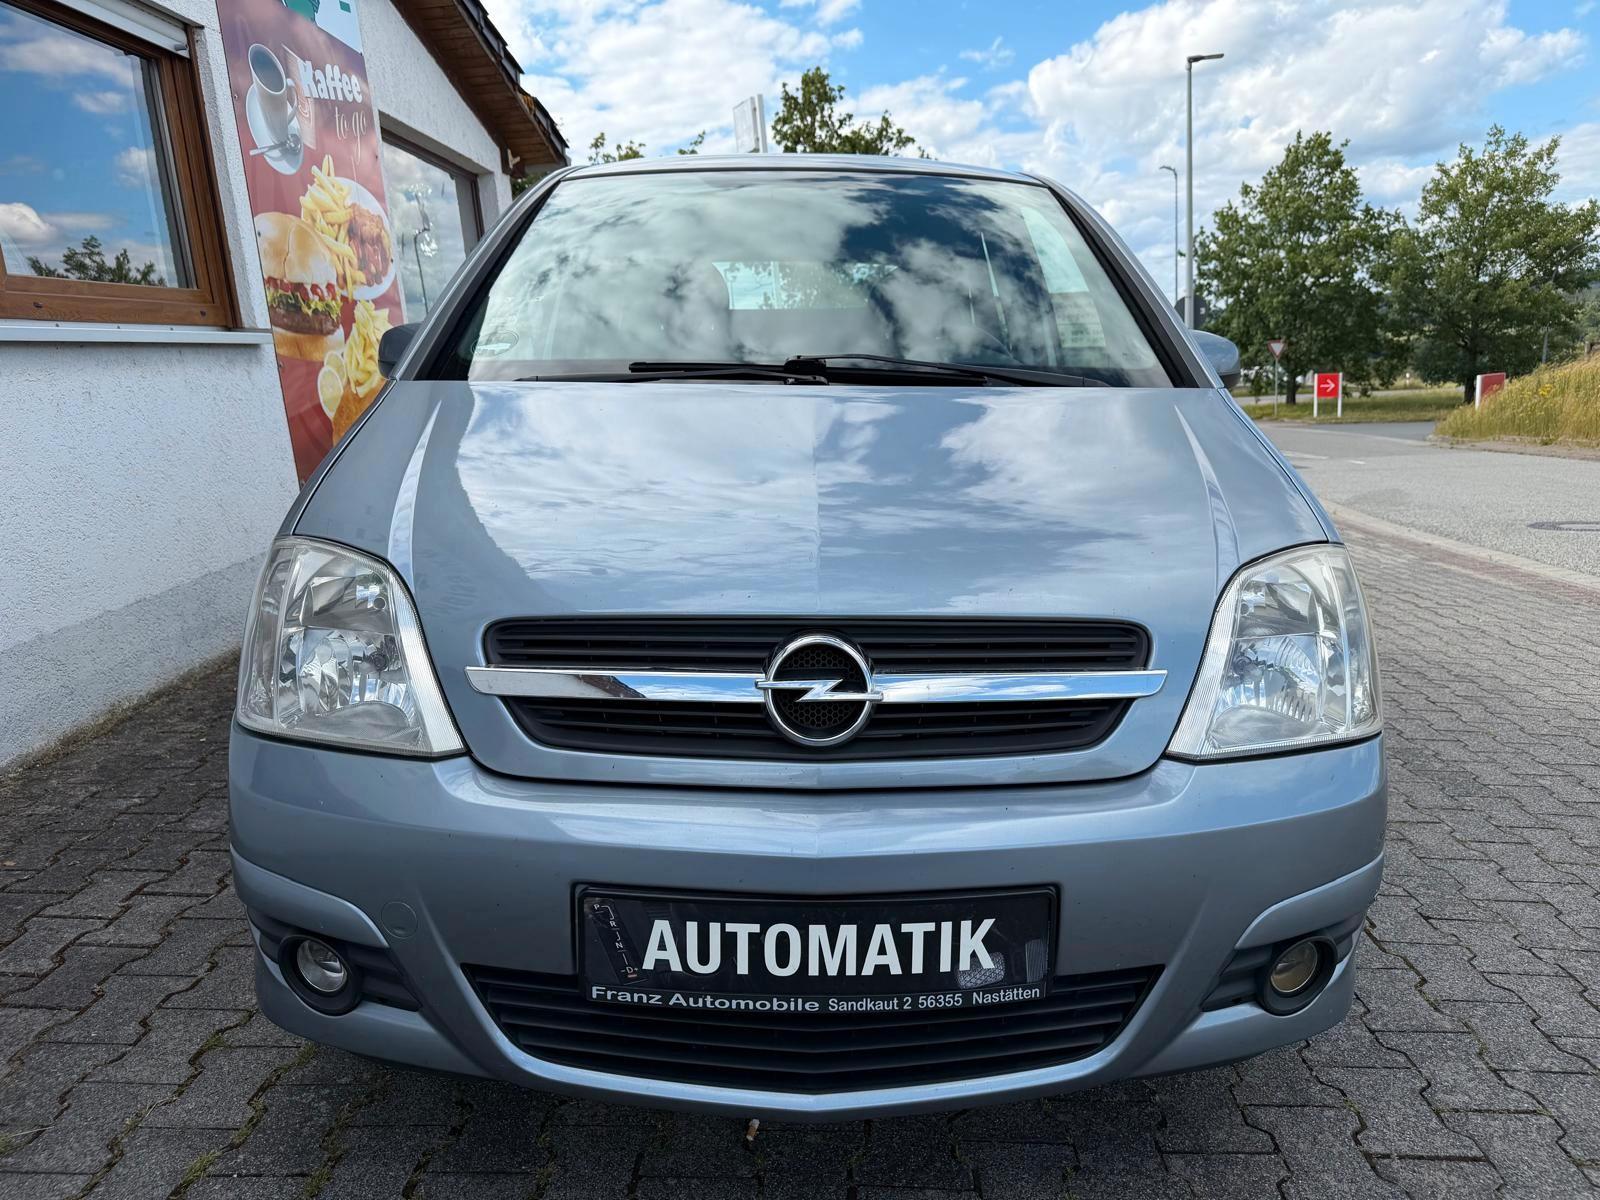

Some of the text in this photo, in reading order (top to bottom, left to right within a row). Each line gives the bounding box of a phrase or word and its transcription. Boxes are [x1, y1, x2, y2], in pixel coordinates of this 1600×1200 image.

[297, 60, 363, 104] Kaffee
[335, 106, 367, 166] to go
[641, 918, 996, 977] AUTOMATIK
[591, 985, 1041, 1012] Franz Automobile Sandkaut 2 56355 Nastätten
